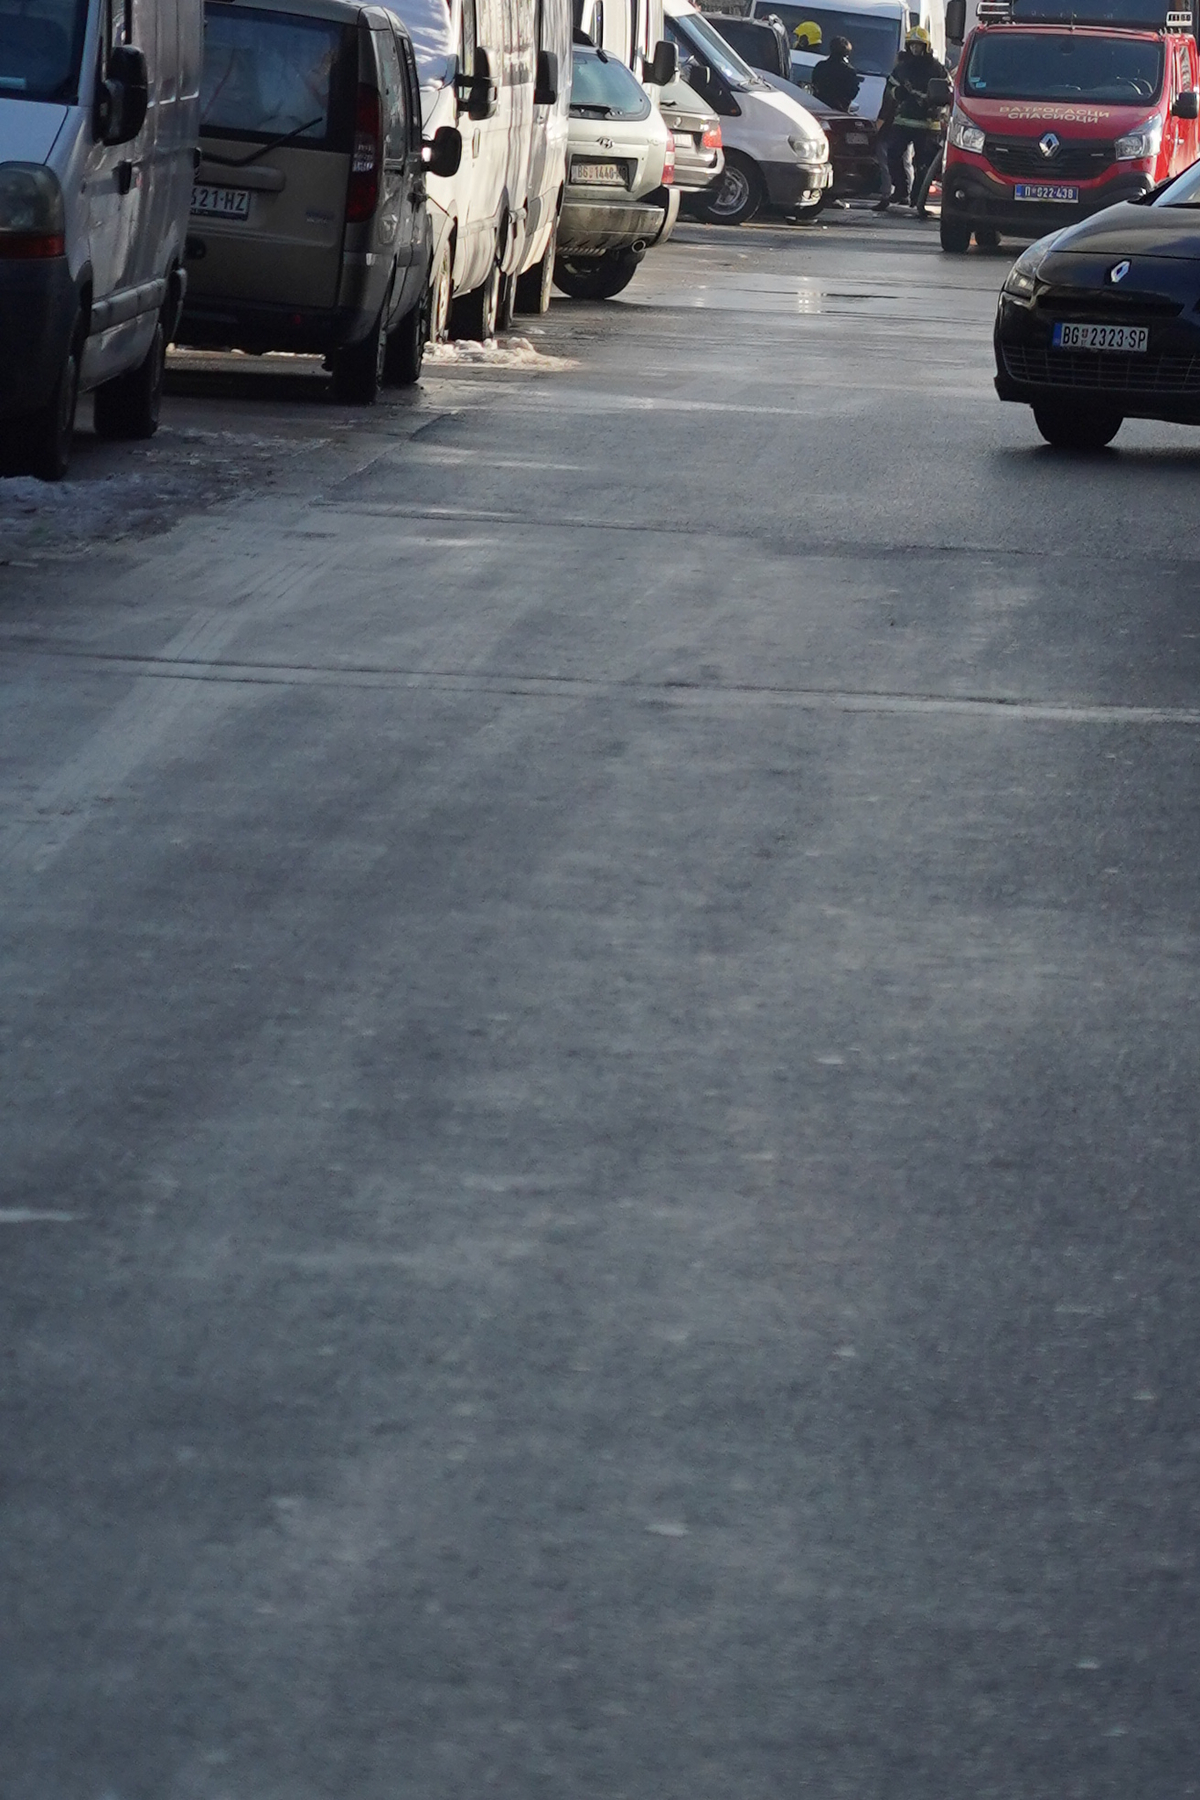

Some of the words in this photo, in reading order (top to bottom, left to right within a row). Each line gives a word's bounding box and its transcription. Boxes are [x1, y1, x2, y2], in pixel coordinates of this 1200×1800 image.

[1000, 106, 1110, 118] ВАТРОГАСЦИ
[1008, 112, 1098, 123] СПАСИОЦИ
[1062, 326, 1080, 345] BG
[1090, 328, 1146, 349] 2323-SP
